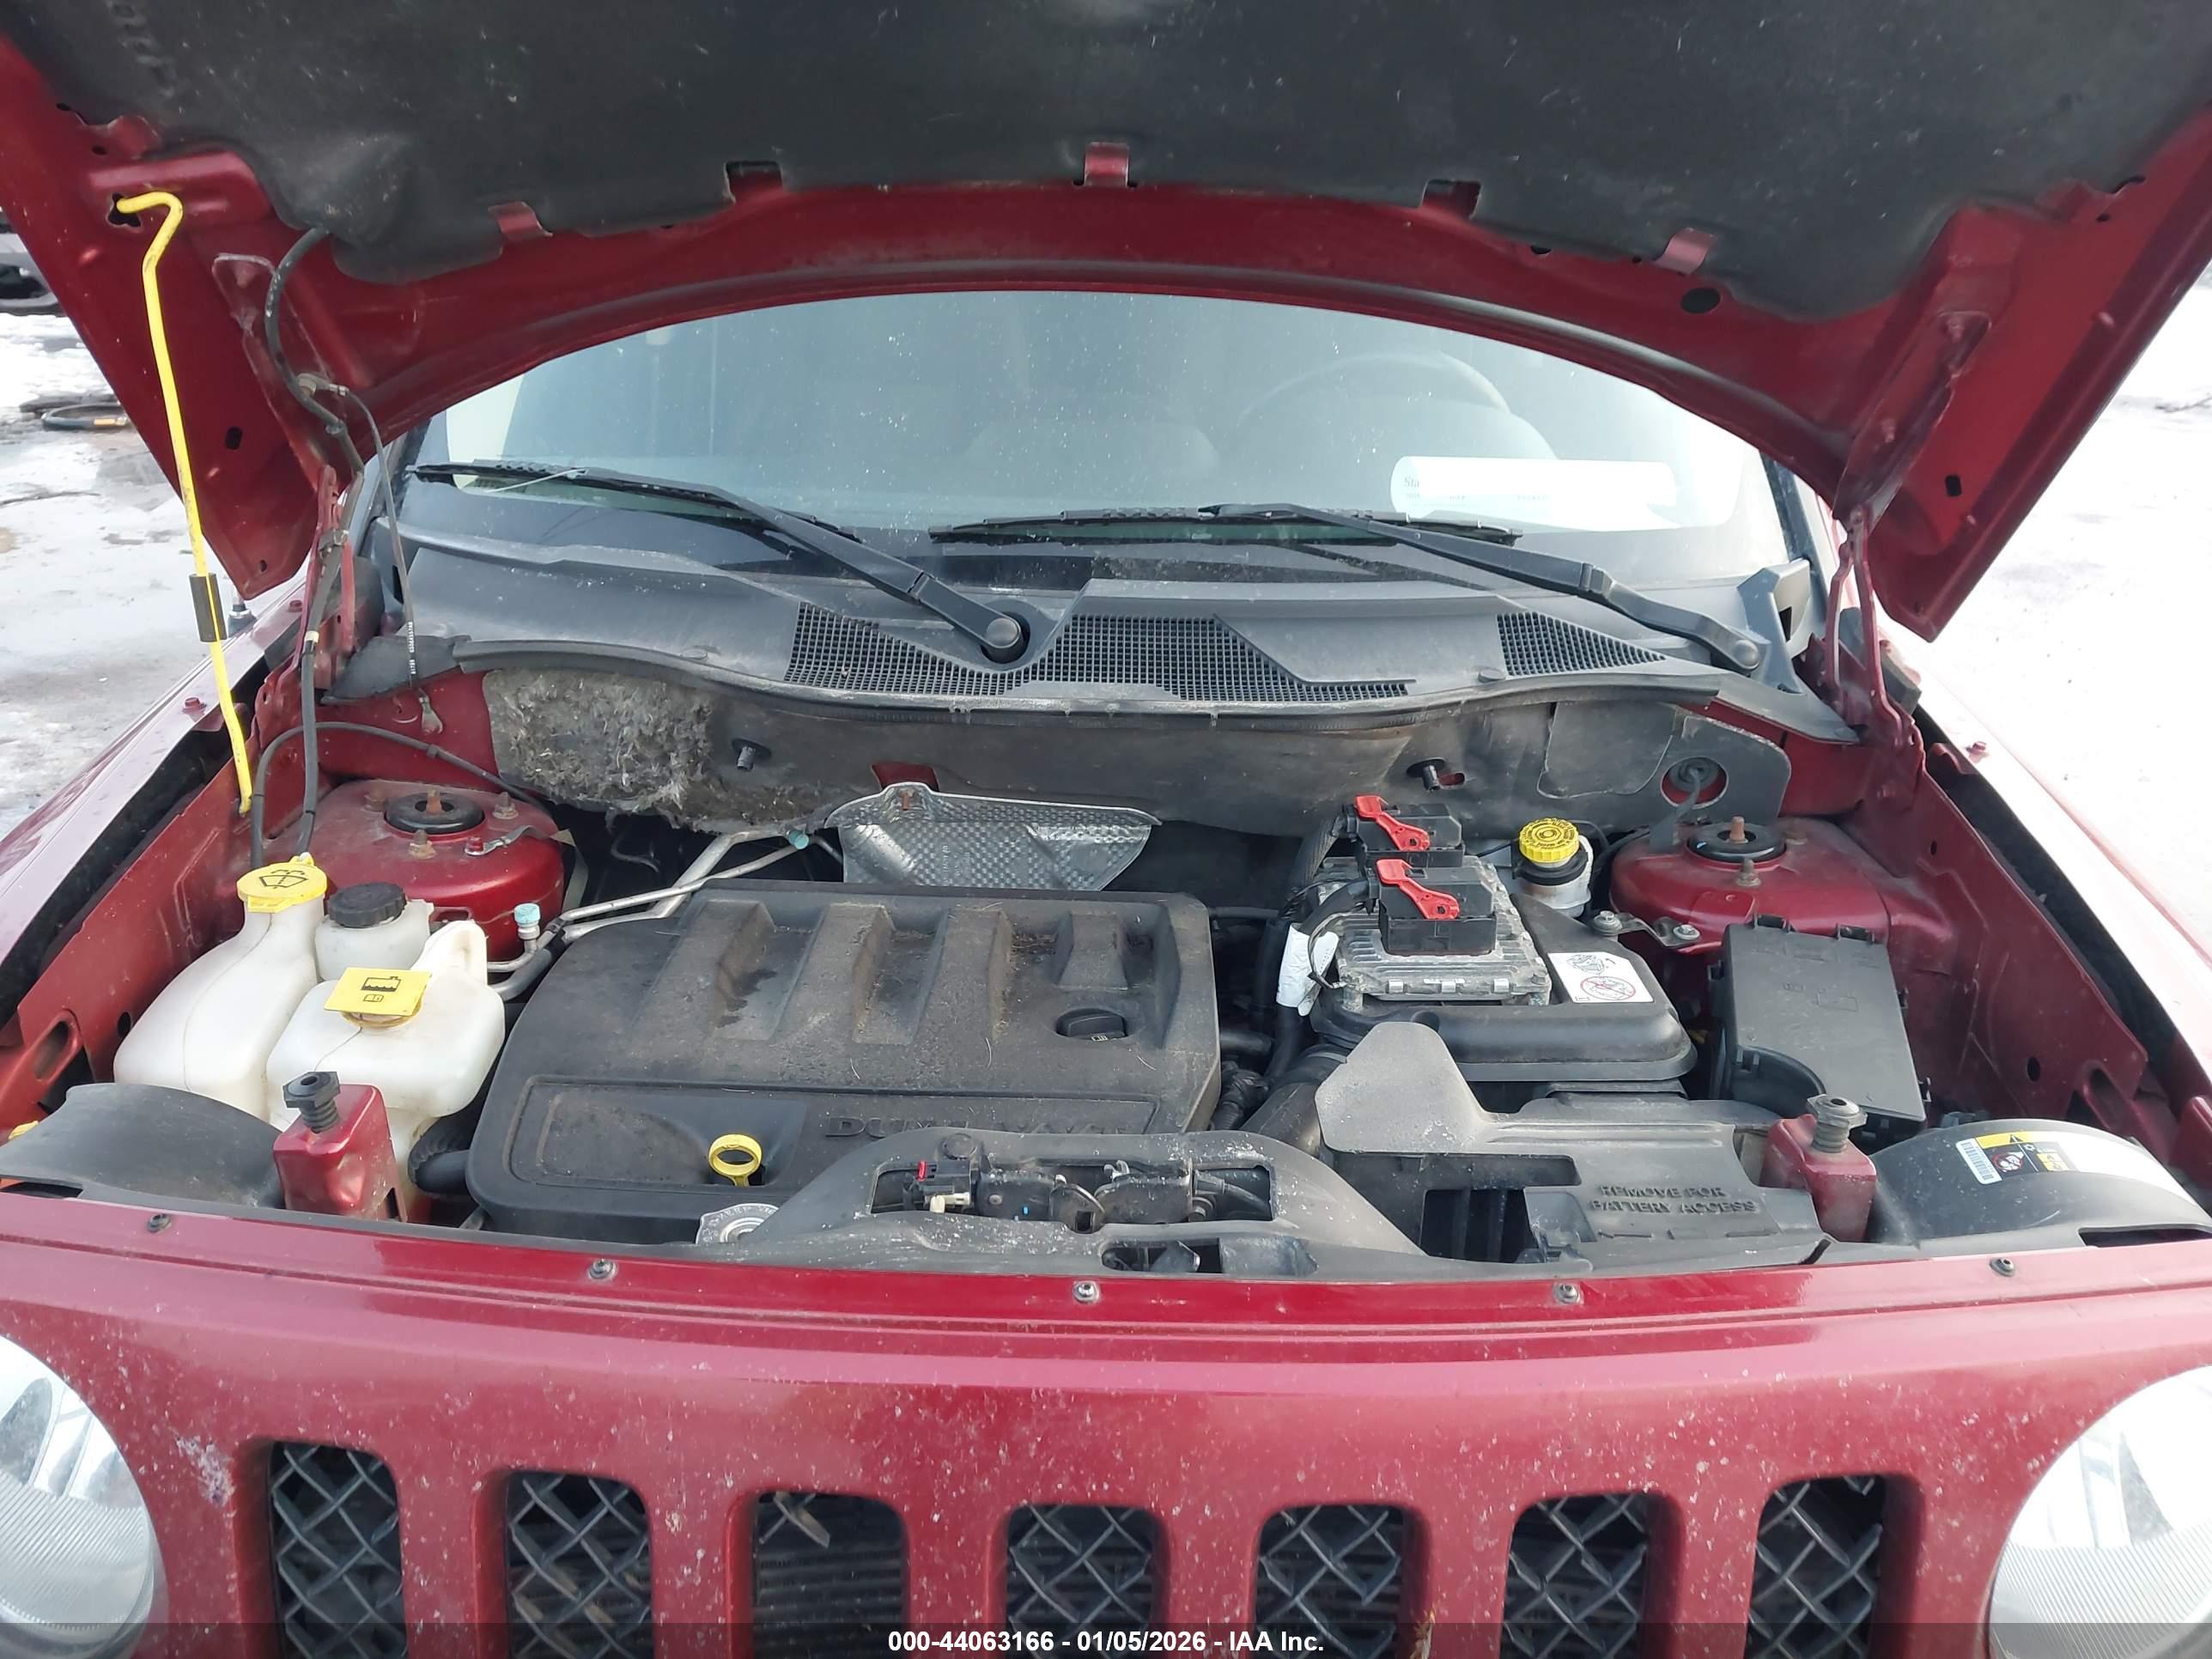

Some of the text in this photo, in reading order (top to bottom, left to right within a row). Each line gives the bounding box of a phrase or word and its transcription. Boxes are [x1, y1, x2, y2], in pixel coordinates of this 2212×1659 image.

[1600, 1185, 1728, 1198] REMOVE FOR
[1589, 1200, 1758, 1214] BATTERY ACCESS
